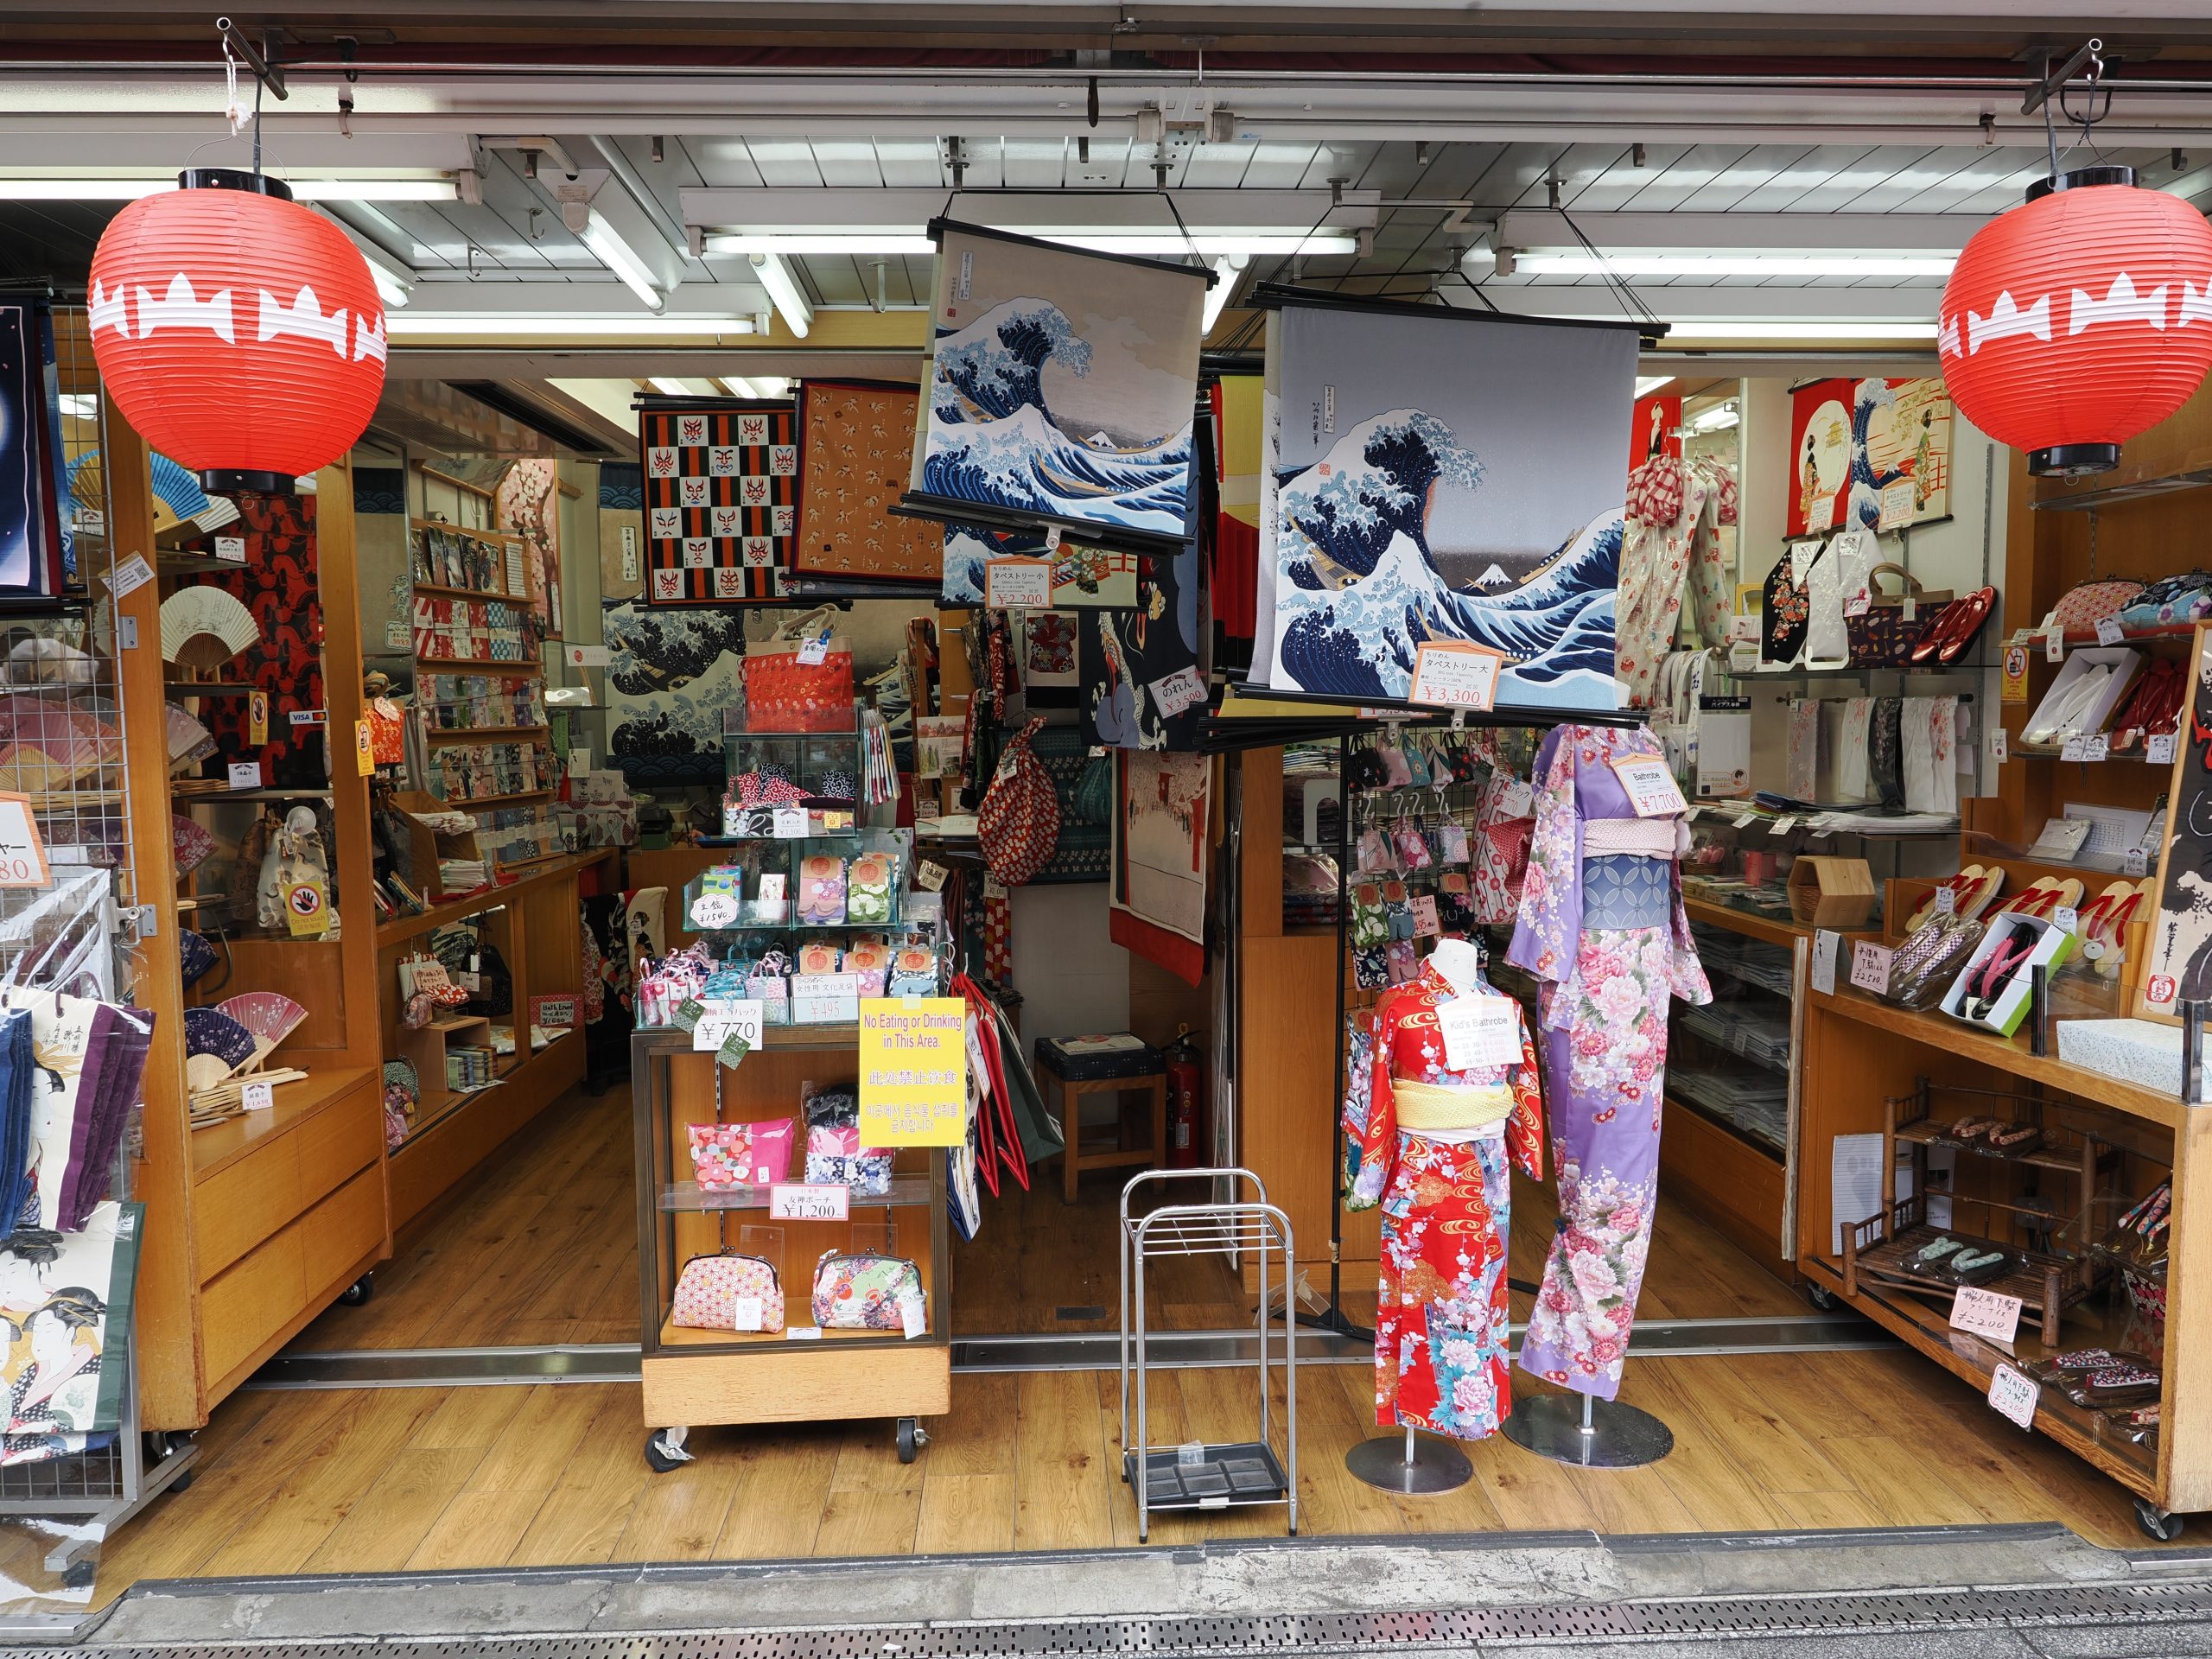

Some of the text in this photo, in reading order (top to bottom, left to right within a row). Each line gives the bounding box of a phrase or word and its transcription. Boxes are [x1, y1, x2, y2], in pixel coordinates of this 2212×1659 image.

[996, 594, 1043, 605] ¥2200
[1162, 679, 1193, 697] のれん
[1422, 685, 1480, 704] ¥3,300
[1633, 772, 1660, 781] Bathrobe
[1637, 793, 1681, 812] ¥7,700
[810, 1001, 840, 1020] ¥495
[701, 1022, 756, 1039] ¥770
[864, 1014, 962, 1032] No Eating or Drinking
[1451, 1016, 1508, 1030] Kid's Bathrobe
[883, 1033, 941, 1048] in This Area.
[868, 1070, 957, 1085] 此处禁止饮食
[866, 1103, 958, 1118] 이곳에서 음식물 섭취를
[891, 1119, 934, 1133] 금지합니다
[789, 1195, 831, 1204] 友禅ポーチ
[782, 1205, 836, 1218] ¥1,200
